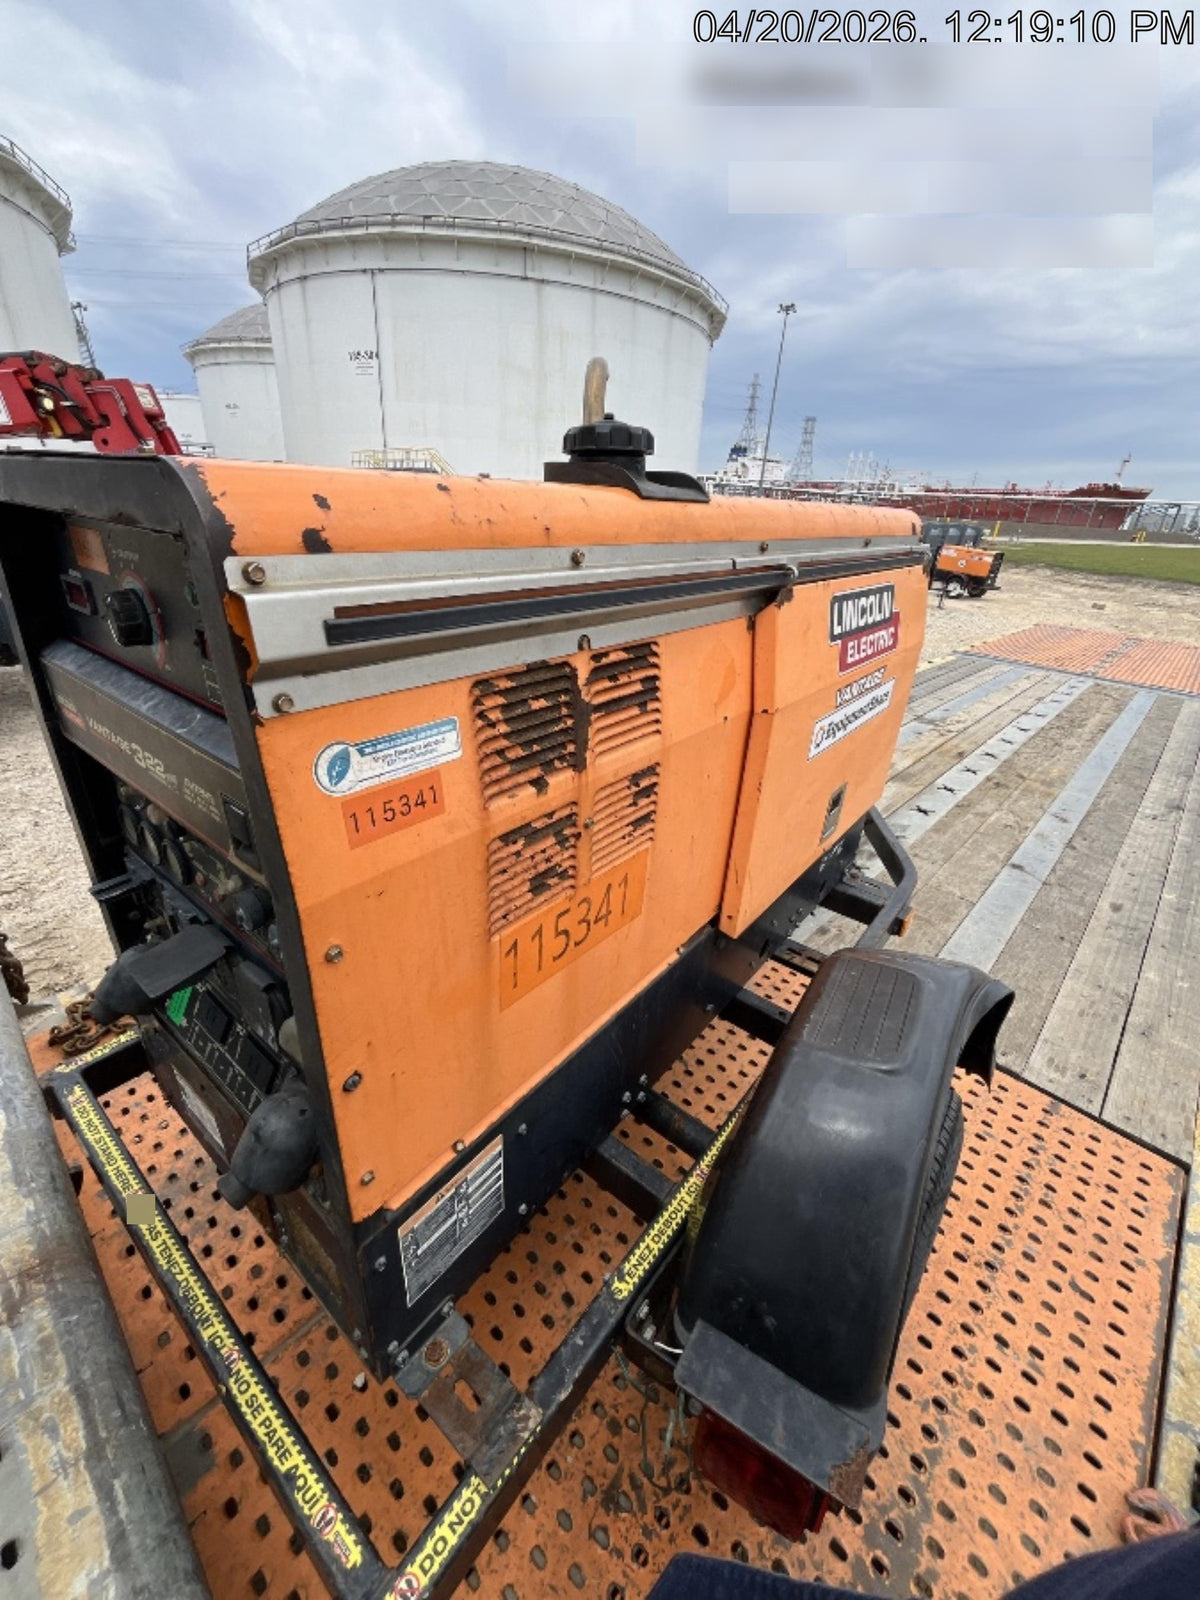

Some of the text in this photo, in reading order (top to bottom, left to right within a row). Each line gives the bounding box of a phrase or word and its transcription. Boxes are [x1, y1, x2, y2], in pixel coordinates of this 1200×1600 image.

[833, 590, 892, 636] LINCOLN
[846, 626, 896, 664] ELECTRIC
[349, 784, 439, 834] 115341
[504, 872, 629, 989] 115341
[75, 1106, 134, 1193] DO NOT STAND HERE
[651, 1198, 688, 1243] DEBOUT
[230, 1369, 251, 1393] NO
[245, 1393, 266, 1419] SE
[259, 1416, 292, 1465] PARE
[419, 1535, 448, 1577] DO
